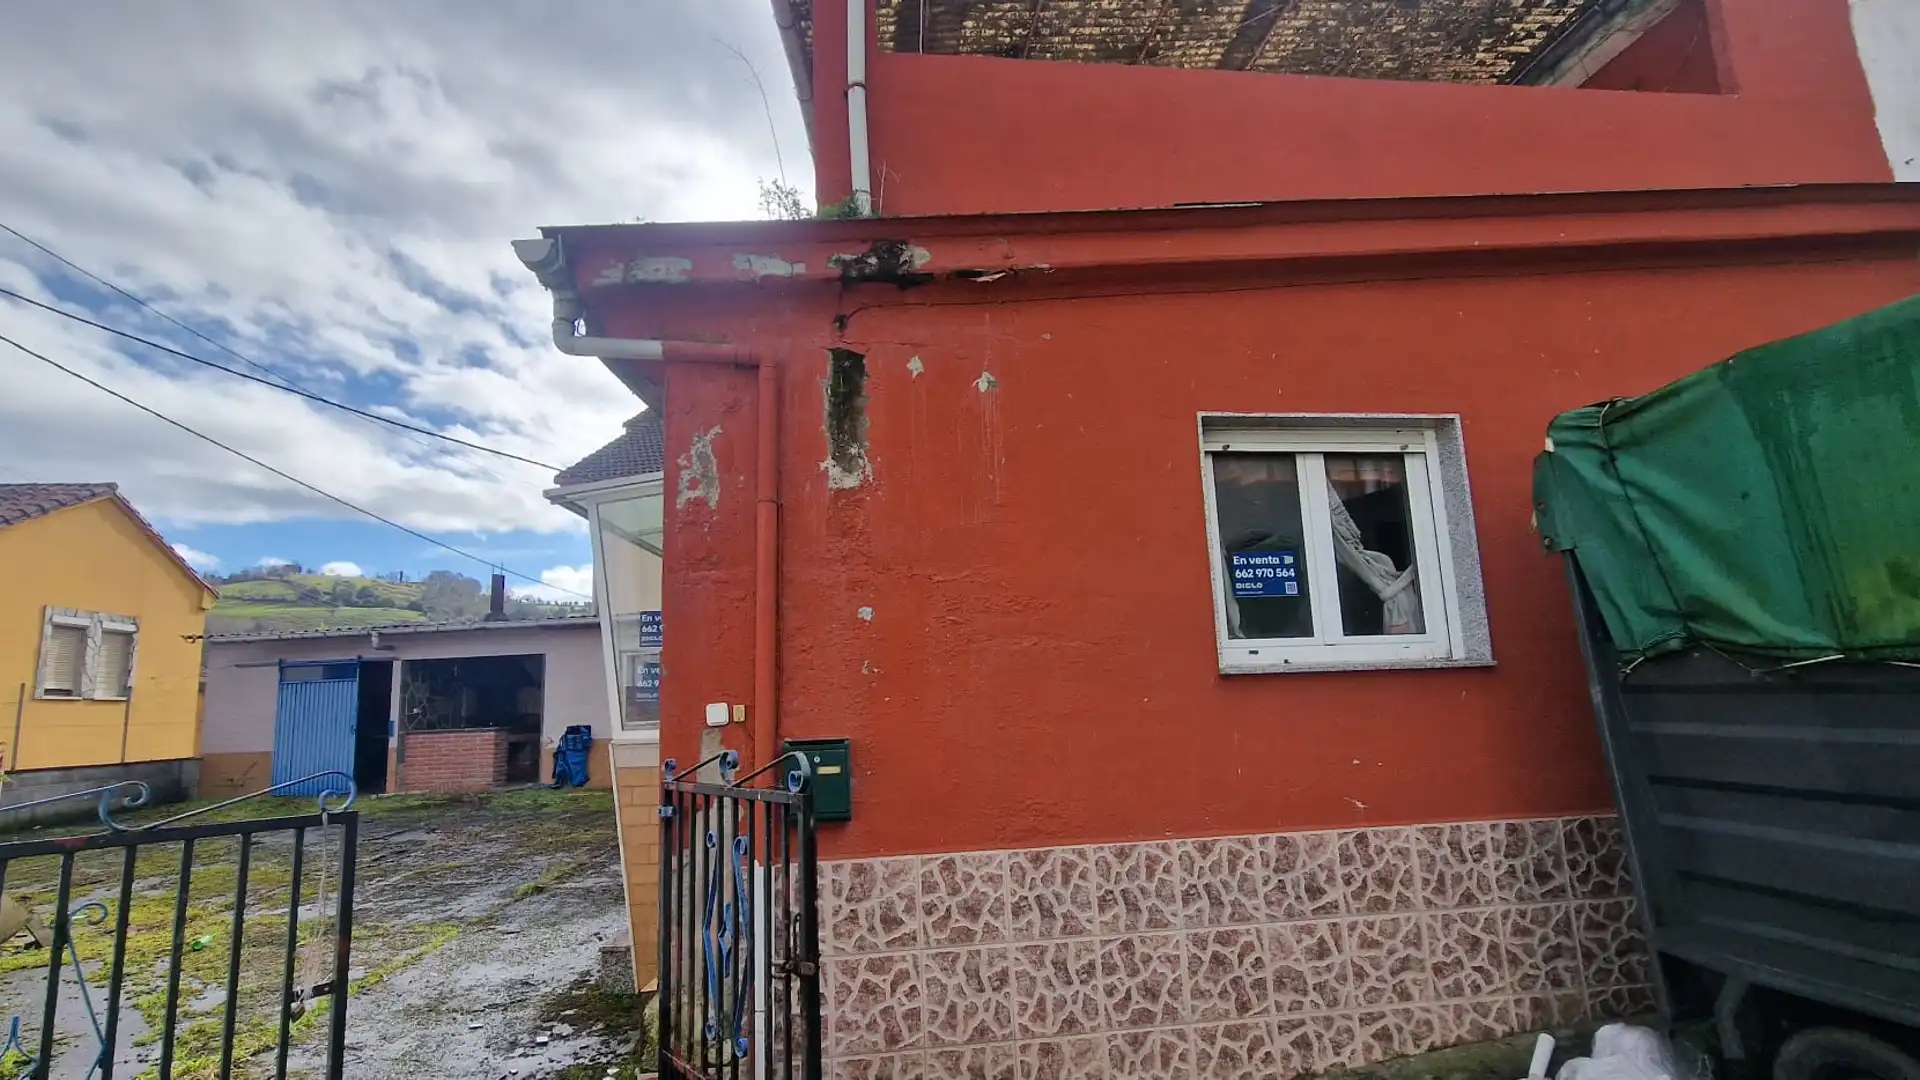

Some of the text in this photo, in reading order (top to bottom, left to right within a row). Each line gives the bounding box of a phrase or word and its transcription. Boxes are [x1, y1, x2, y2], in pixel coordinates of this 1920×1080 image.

[1233, 555, 1280, 565] En venta
[1235, 568, 1295, 578] 662 970 564
[641, 614, 653, 622] En
[642, 624, 658, 632] 662
